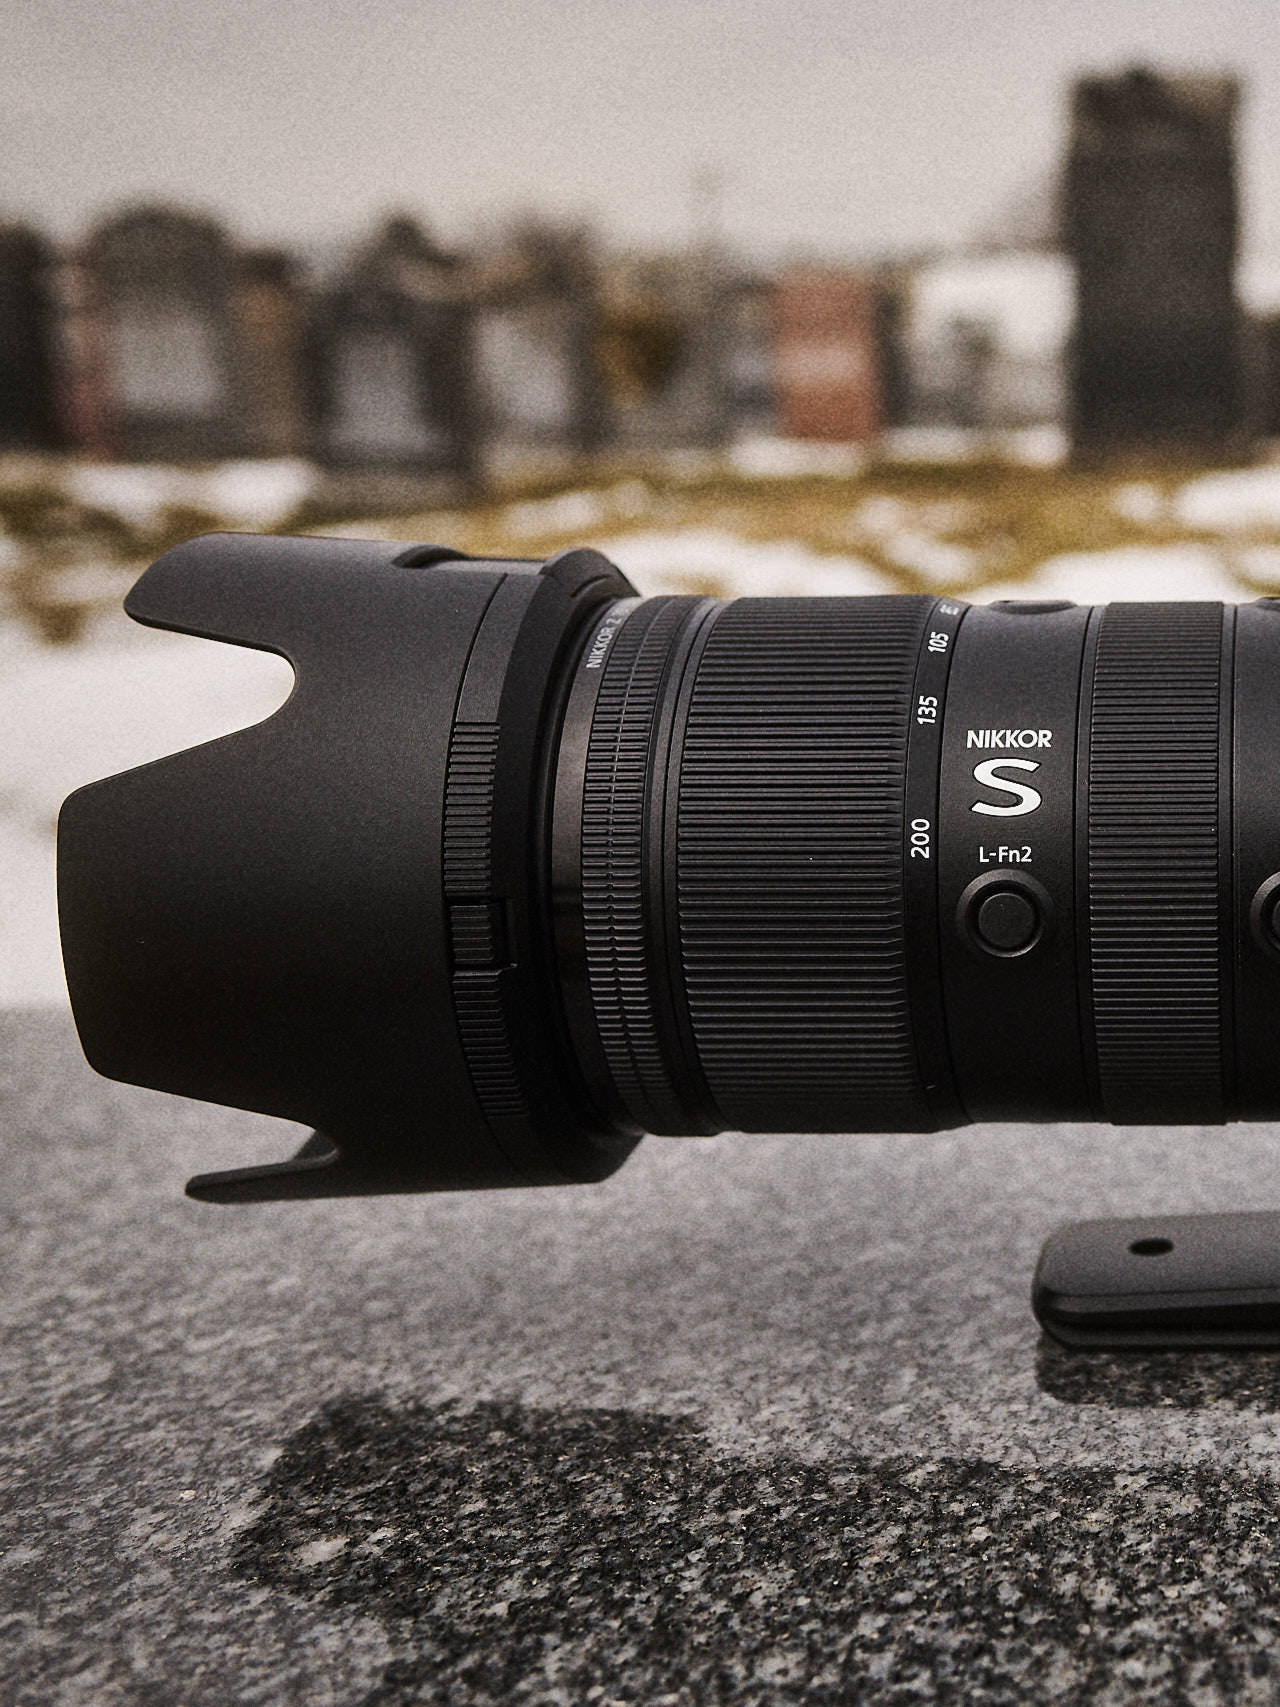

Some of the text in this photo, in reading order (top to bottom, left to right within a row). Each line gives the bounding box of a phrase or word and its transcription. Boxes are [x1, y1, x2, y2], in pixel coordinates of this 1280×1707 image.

[586, 626, 618, 669] NIKKOR
[927, 631, 949, 653] 105
[917, 695, 938, 725] 135
[966, 729, 1053, 749] NIKKOR
[970, 757, 1042, 817] S
[910, 818, 931, 859] 200
[979, 845, 1033, 863] L-Fn2
